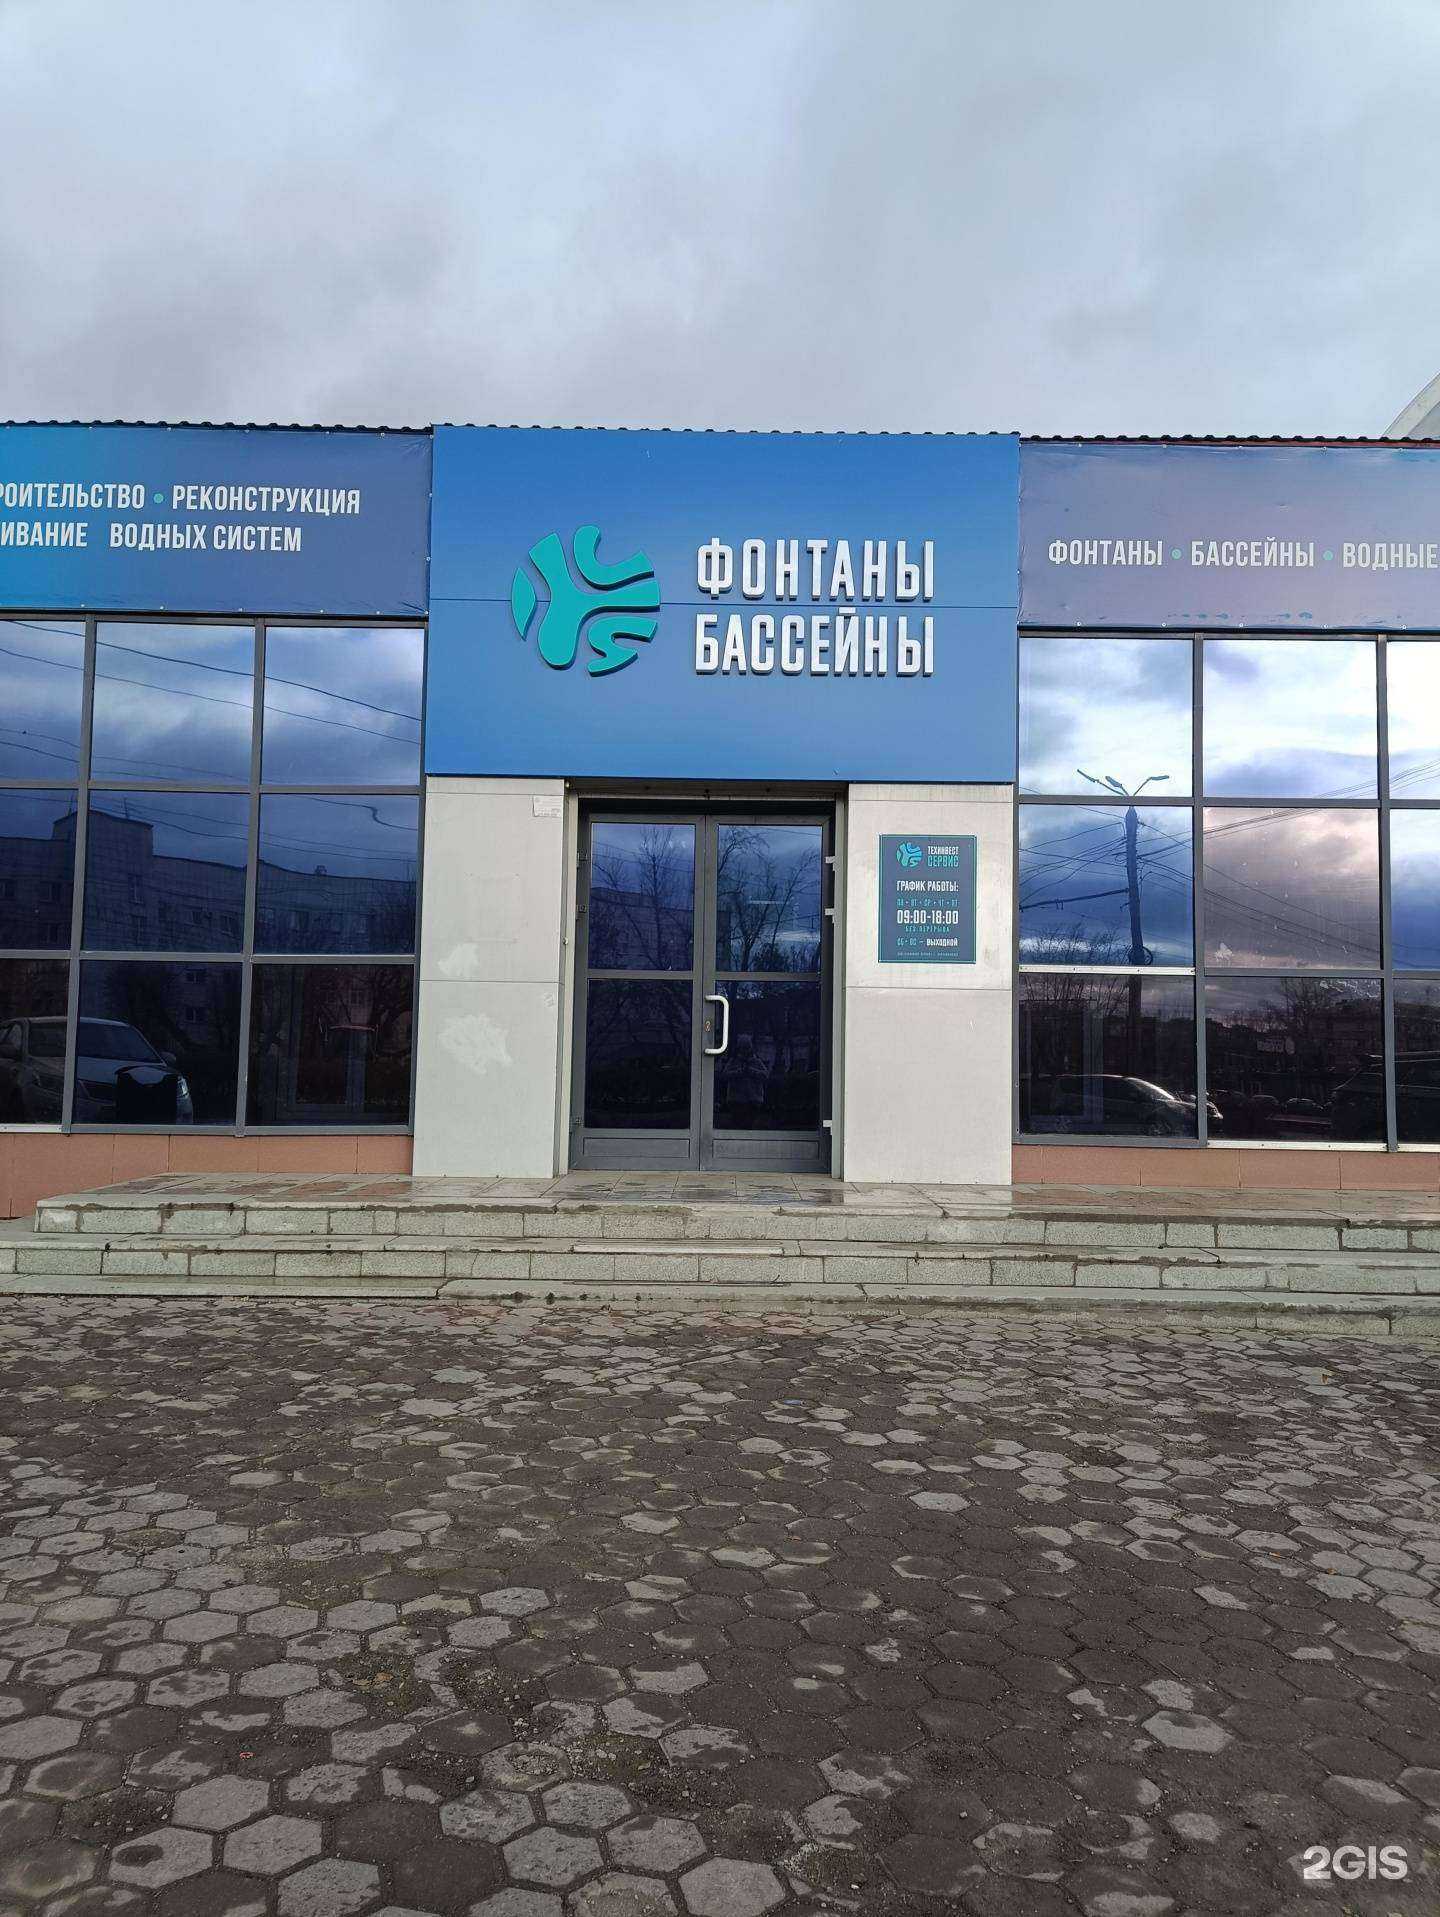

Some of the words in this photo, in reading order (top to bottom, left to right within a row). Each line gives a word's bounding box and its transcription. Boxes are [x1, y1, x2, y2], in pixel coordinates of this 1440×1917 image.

[172, 484, 361, 516] РЕКОНСТРУКЦИЯ
[0, 521, 88, 547] ИВАНИЕ
[110, 522, 206, 551] ВОДНЫХ
[213, 525, 302, 552] СИСТЕМ
[1049, 539, 1163, 566] ФОНТАНЫ
[1191, 537, 1314, 567] БАССЕЙНЫ
[1343, 542, 1438, 570] ВОДНЫЕ
[697, 537, 934, 600] ФОНТАНЫ
[695, 607, 934, 677] БАССЕЙНЫ
[927, 845, 959, 855] ТЕХИНВЕСТ
[927, 856, 959, 867] СЕРВИС
[896, 880, 926, 892] ГРАФИК
[927, 880, 959, 892] РАБОТЫ:
[896, 909, 959, 924] 09:00-18:00
[926, 938, 958, 947] ВЫХОДНОЙ
